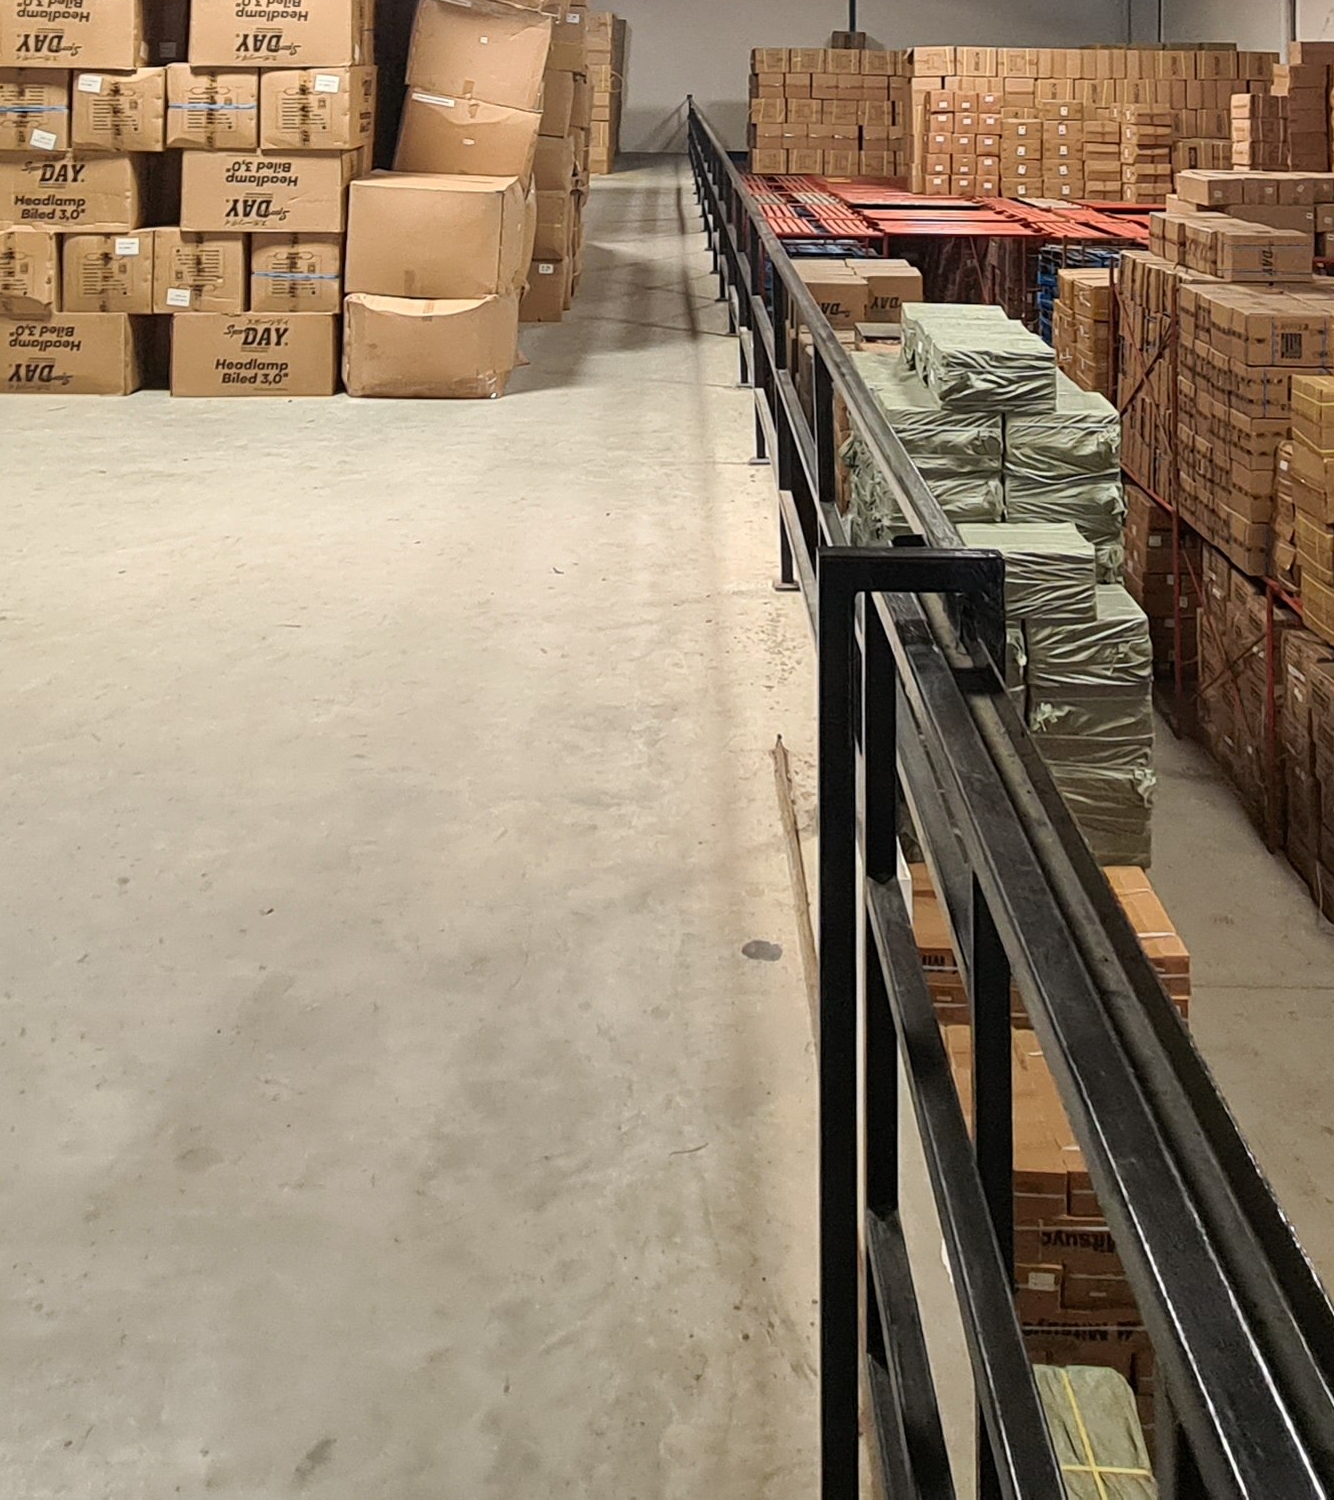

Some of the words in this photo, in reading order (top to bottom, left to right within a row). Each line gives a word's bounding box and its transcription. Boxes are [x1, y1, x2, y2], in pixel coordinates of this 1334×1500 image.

[17, 7, 91, 22] Headlamp
[235, 7, 308, 22] Headlamp
[256, 161, 292, 173] Biled
[225, 172, 298, 187] Headlamp
[14, 194, 86, 209] Headlamp
[21, 208, 56, 220] Biled
[817, 302, 842, 316] DA
[39, 325, 75, 338] Biled
[9, 338, 82, 351] Headlamp
[215, 358, 289, 373] Headlamp
[221, 372, 257, 384] Biled
